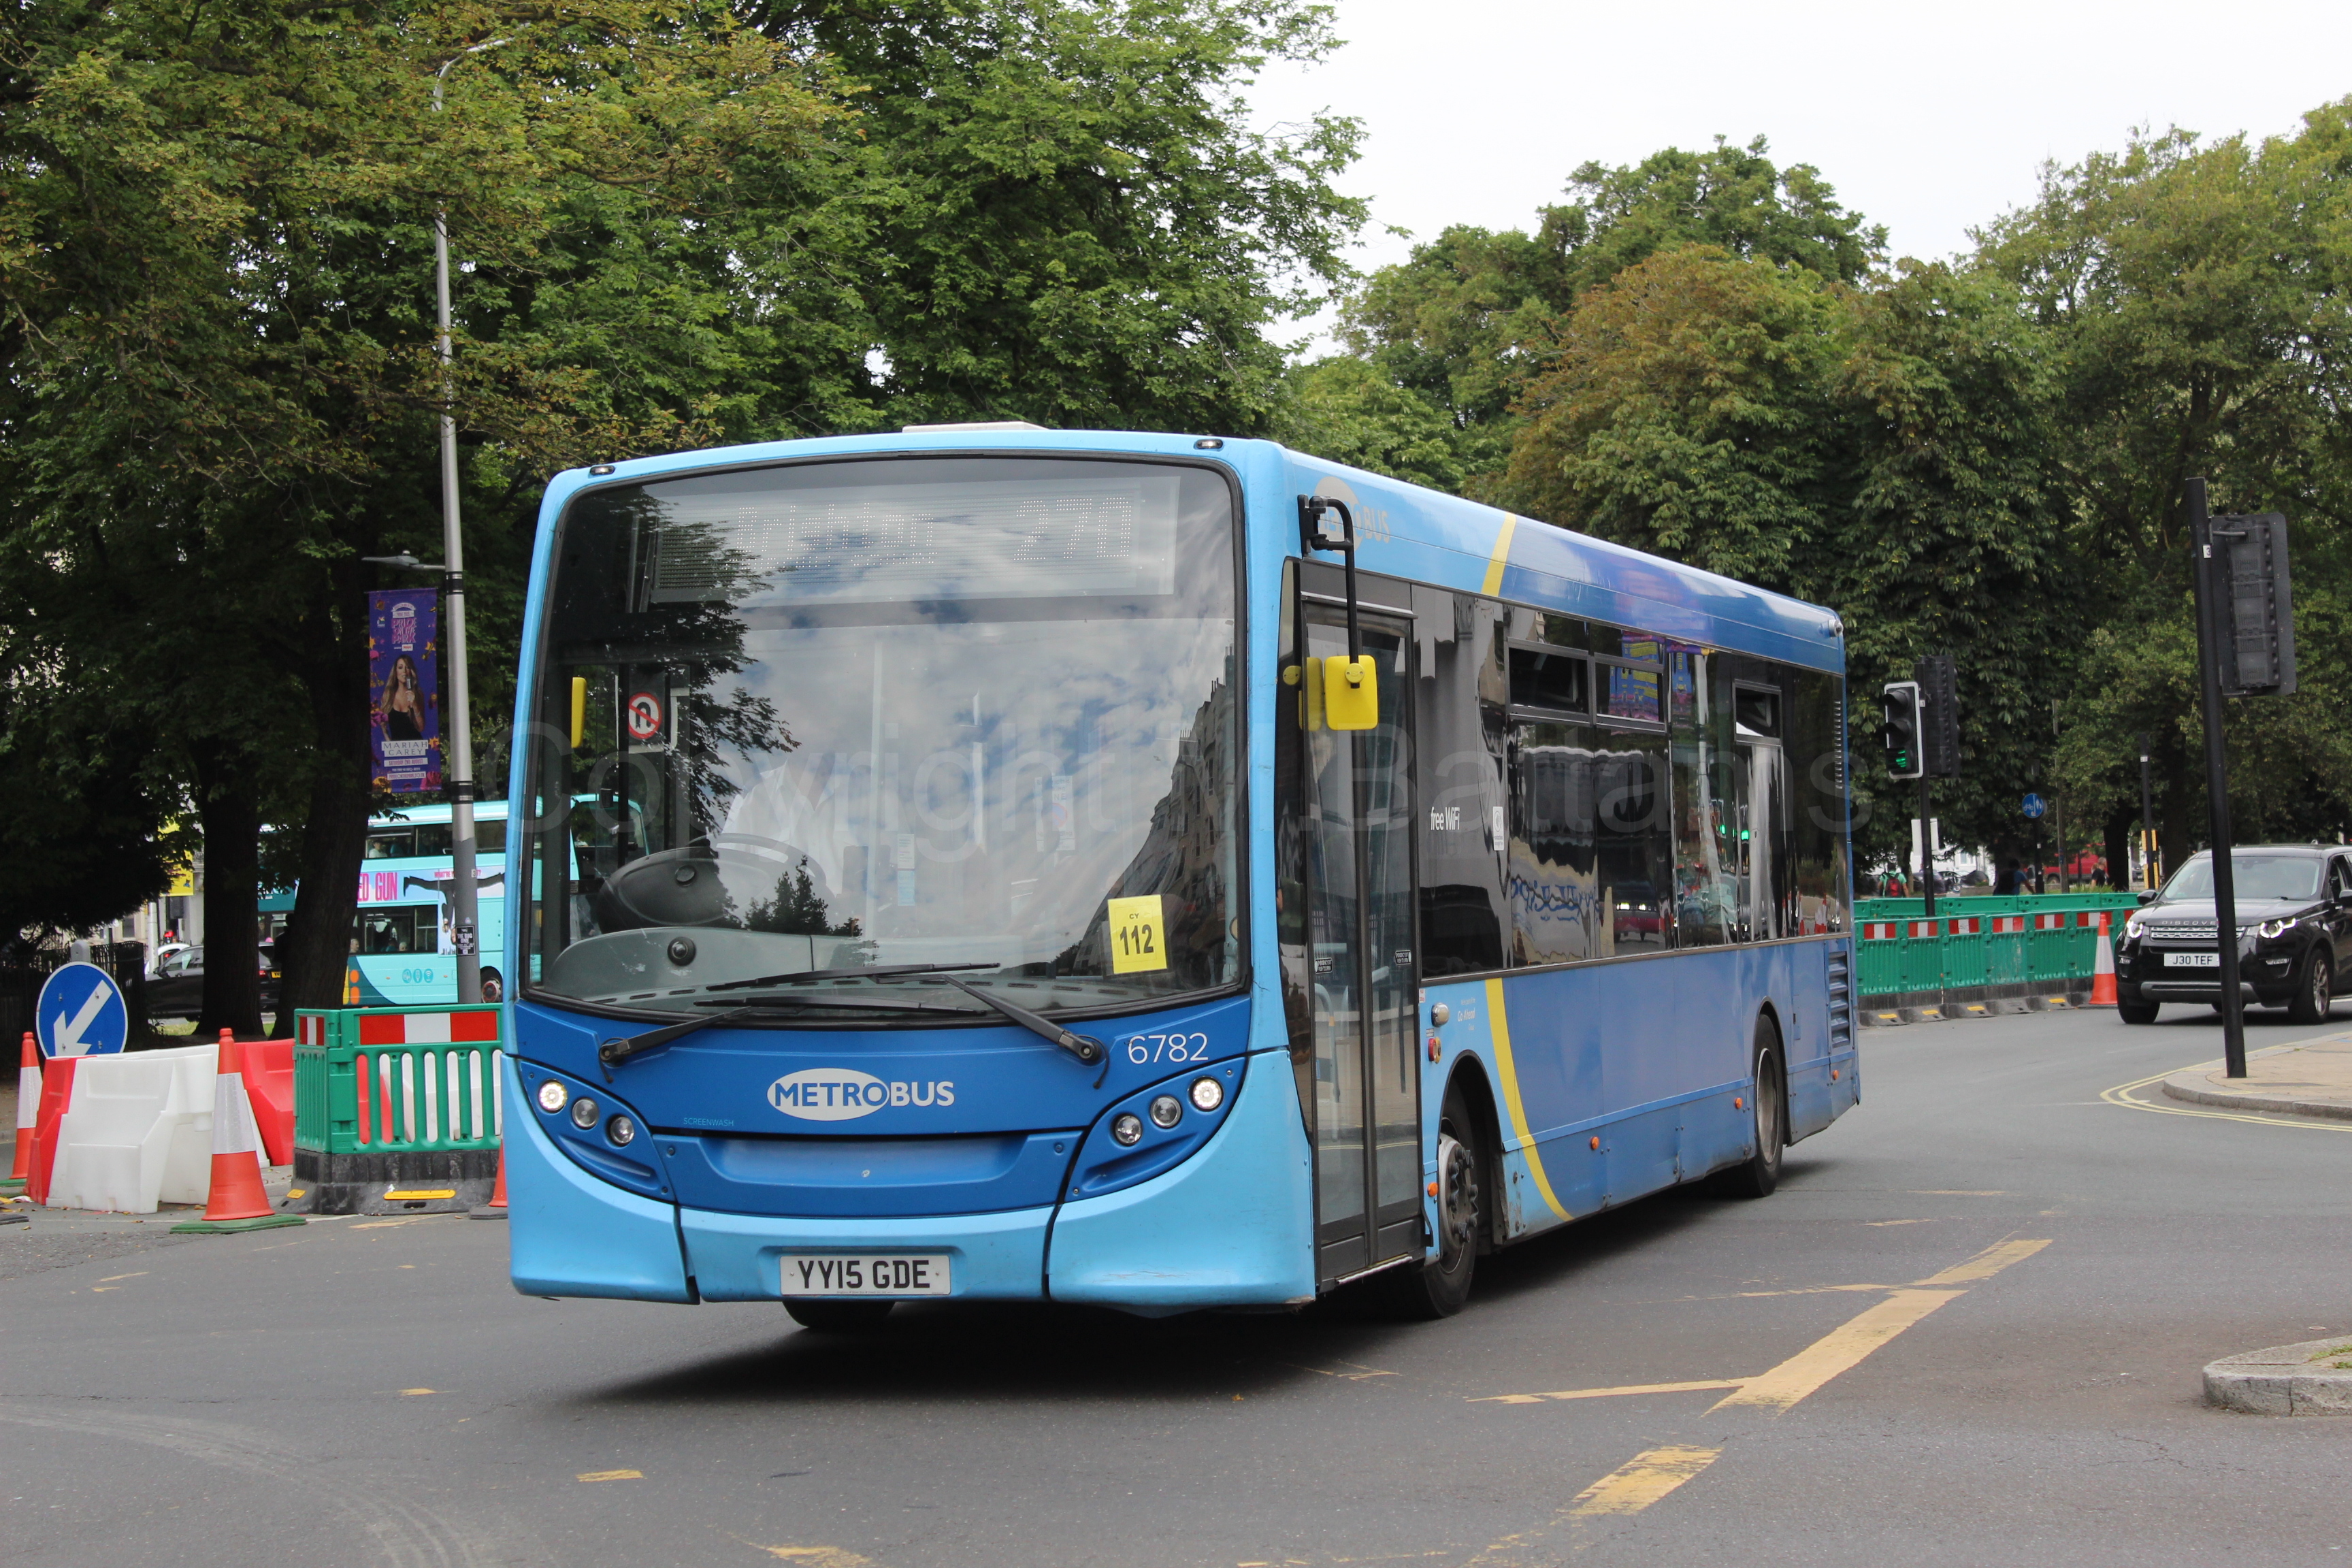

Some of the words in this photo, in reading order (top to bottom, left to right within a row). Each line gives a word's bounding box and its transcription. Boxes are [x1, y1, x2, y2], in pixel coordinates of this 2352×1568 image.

[736, 502, 934, 553] Brighton
[1013, 497, 1132, 560] 270
[391, 618, 417, 629] PRIDE
[392, 633, 416, 644] PARK
[383, 741, 428, 749] MARIAH
[1431, 806, 1444, 831] free
[1445, 806, 1460, 830] WiFi
[357, 872, 370, 902] ED
[375, 872, 398, 902] GUN
[1119, 924, 1154, 956] 112
[2172, 956, 2191, 965] J30
[2195, 956, 2213, 965] TEF
[1127, 1032, 1209, 1065] 6782
[774, 1081, 955, 1107] METROBUS
[683, 1117, 734, 1127] SCREENWASH
[798, 1260, 863, 1289] YY15
[872, 1260, 930, 1289] GDE
